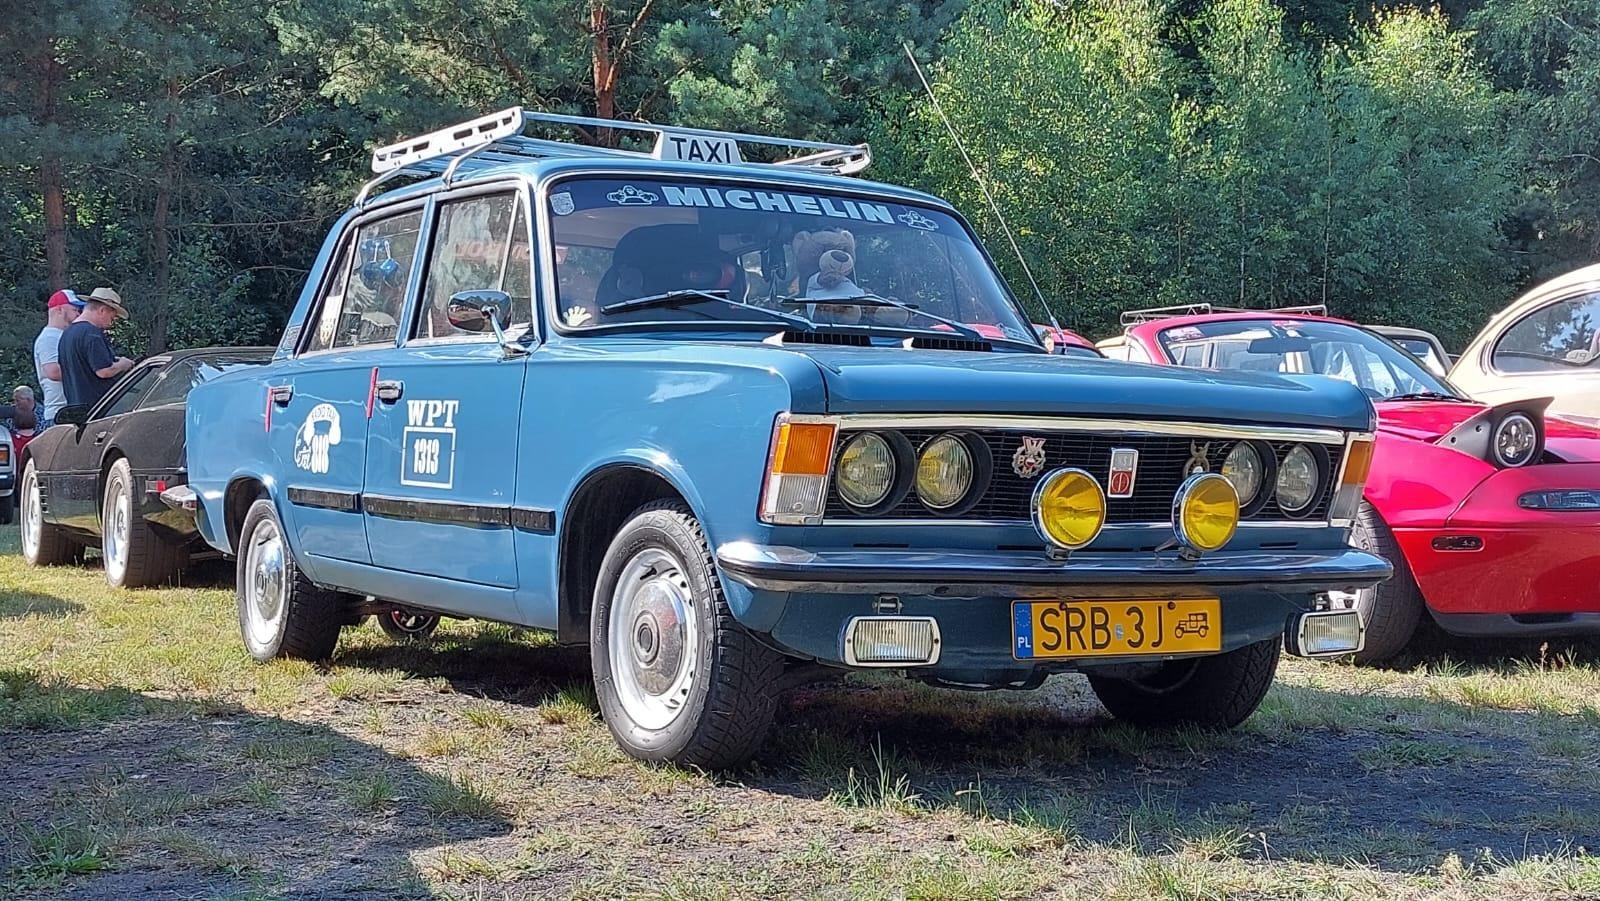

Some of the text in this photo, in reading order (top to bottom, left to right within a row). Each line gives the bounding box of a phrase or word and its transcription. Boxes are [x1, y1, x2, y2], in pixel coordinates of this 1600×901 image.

[669, 137, 731, 164] TAXI
[661, 186, 895, 224] MICHELIN
[406, 400, 459, 427] WPT
[413, 438, 440, 475] 1313
[1017, 636, 1031, 649] PL
[1040, 605, 1163, 650] SRB 3J
